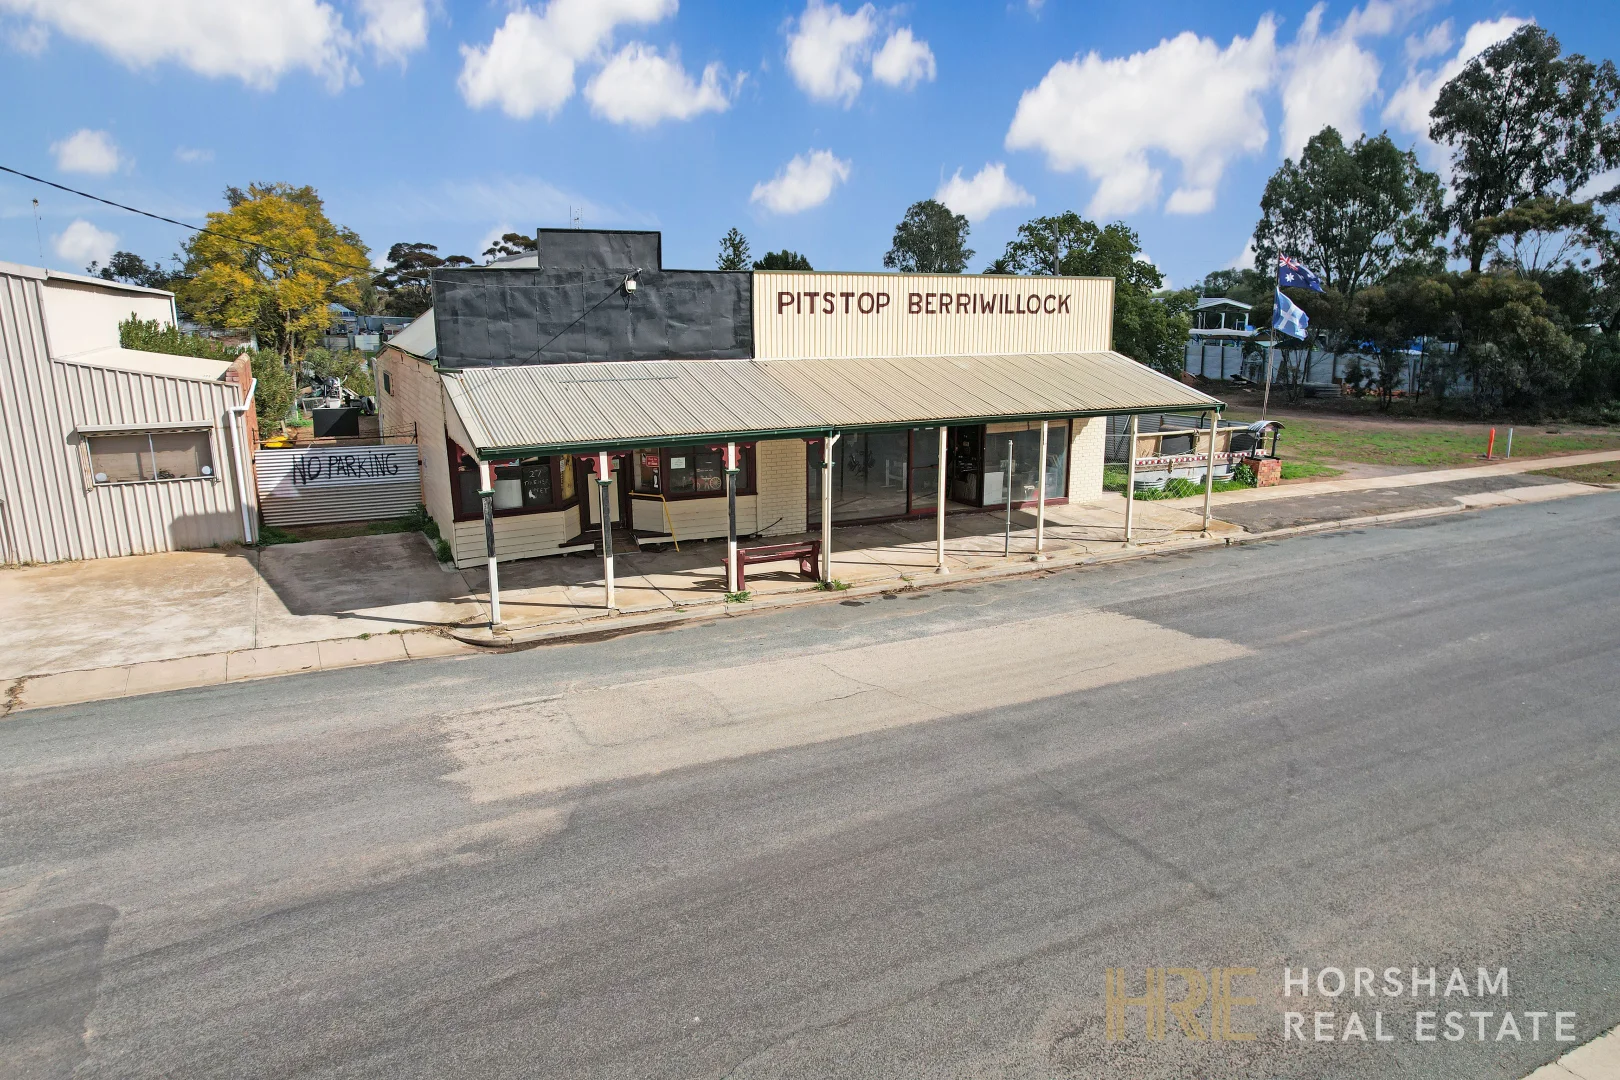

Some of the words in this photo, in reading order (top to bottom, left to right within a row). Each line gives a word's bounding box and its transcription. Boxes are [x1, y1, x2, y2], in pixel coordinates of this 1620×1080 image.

[777, 291, 891, 315] PITSTOP
[908, 292, 1072, 315] BERRIWILLOCK
[292, 453, 322, 485] NO
